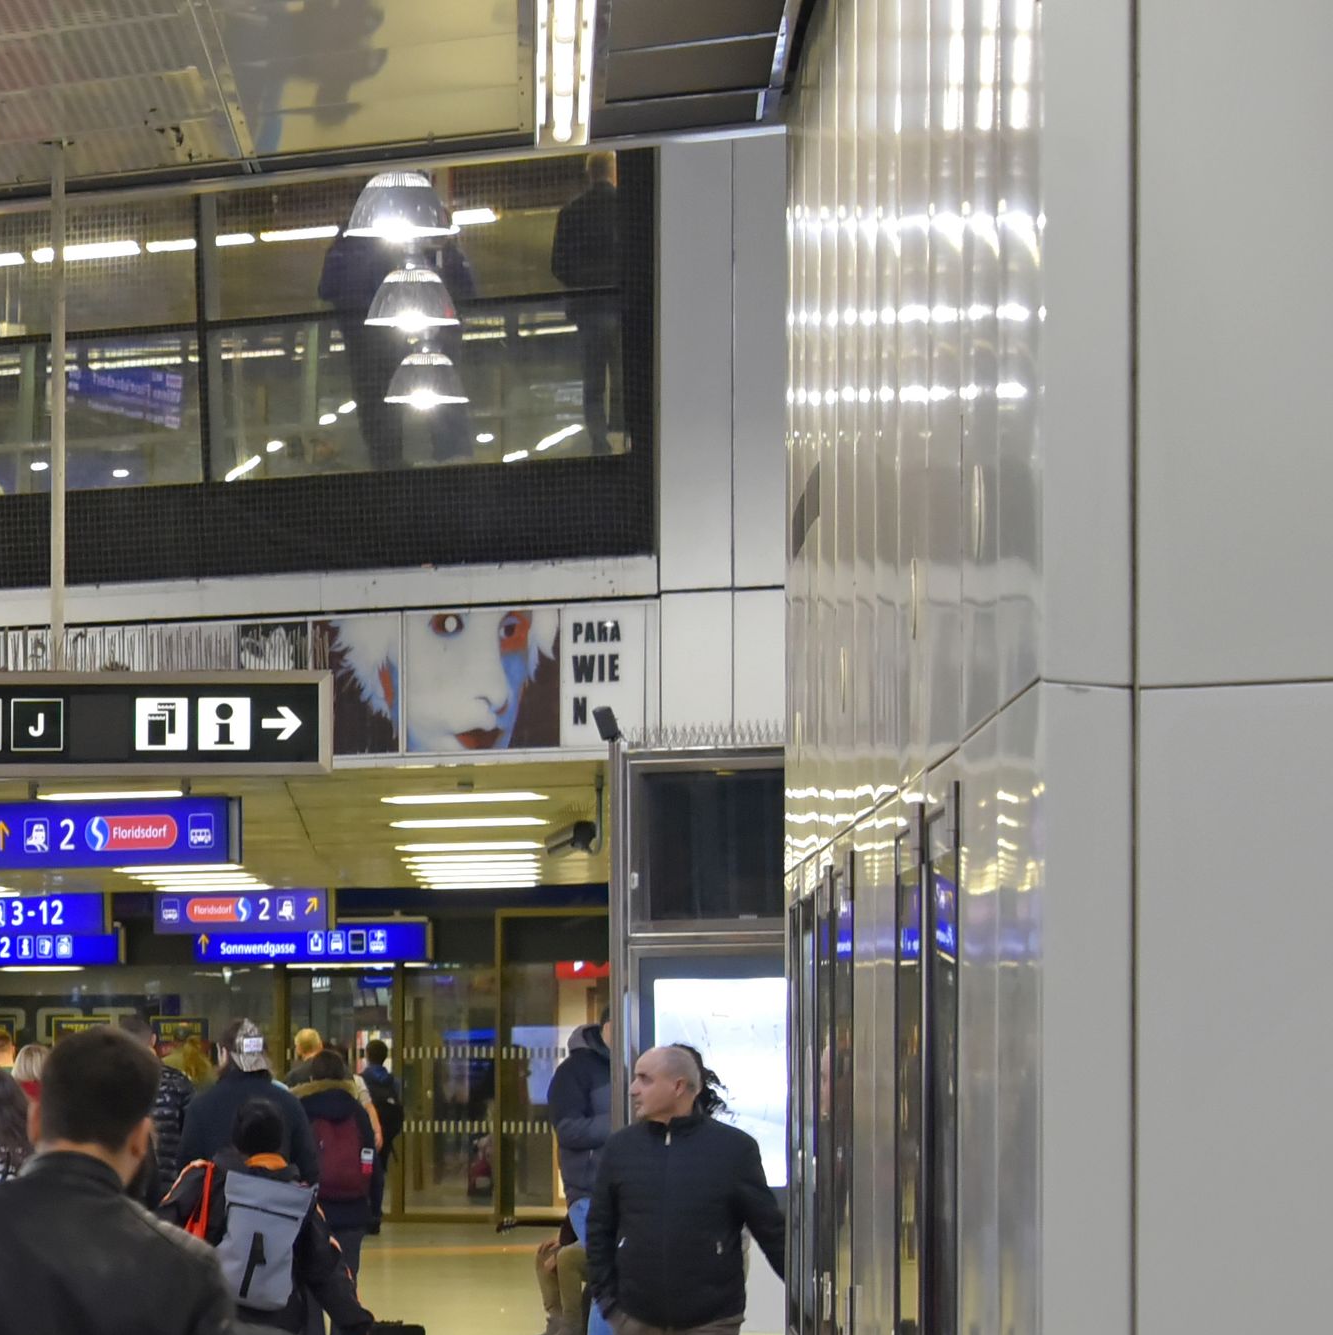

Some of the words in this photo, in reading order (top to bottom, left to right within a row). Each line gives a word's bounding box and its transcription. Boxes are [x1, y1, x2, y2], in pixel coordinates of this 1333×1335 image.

[572, 619, 622, 643] PARA
[572, 654, 621, 683] WIE
[572, 696, 588, 726] N
[28, 713, 45, 737] J
[59, 818, 75, 851] 2
[113, 824, 167, 840] Floridsdorf
[193, 903, 233, 916] Floridsdorf
[258, 898, 270, 921] 2
[220, 941, 296, 957] Sonnwendgasse
